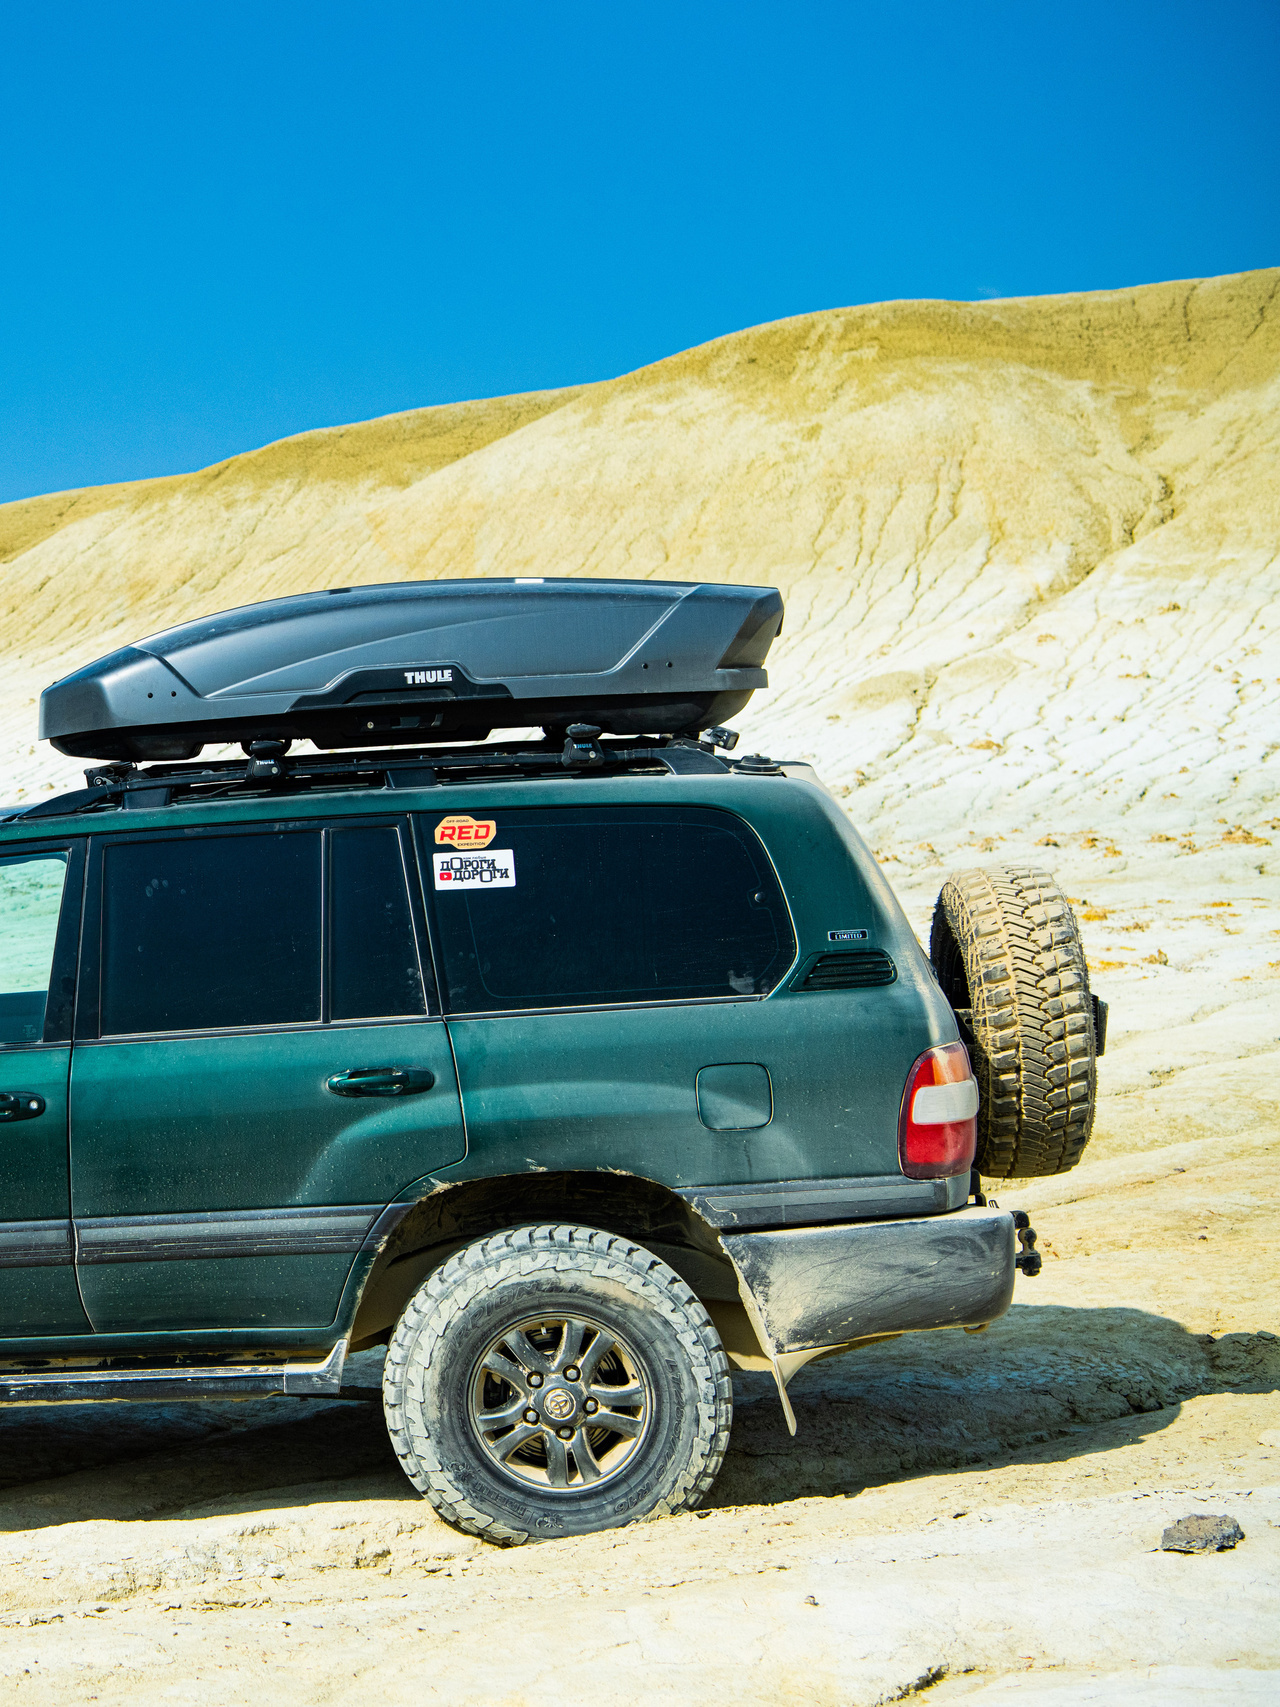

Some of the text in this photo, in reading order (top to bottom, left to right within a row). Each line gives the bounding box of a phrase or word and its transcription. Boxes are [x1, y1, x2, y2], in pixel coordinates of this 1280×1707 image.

[404, 669, 453, 684] THULE
[439, 824, 491, 841] RED
[440, 857, 497, 872] ДОРОГИ
[453, 868, 510, 883] ДОРОГИ
